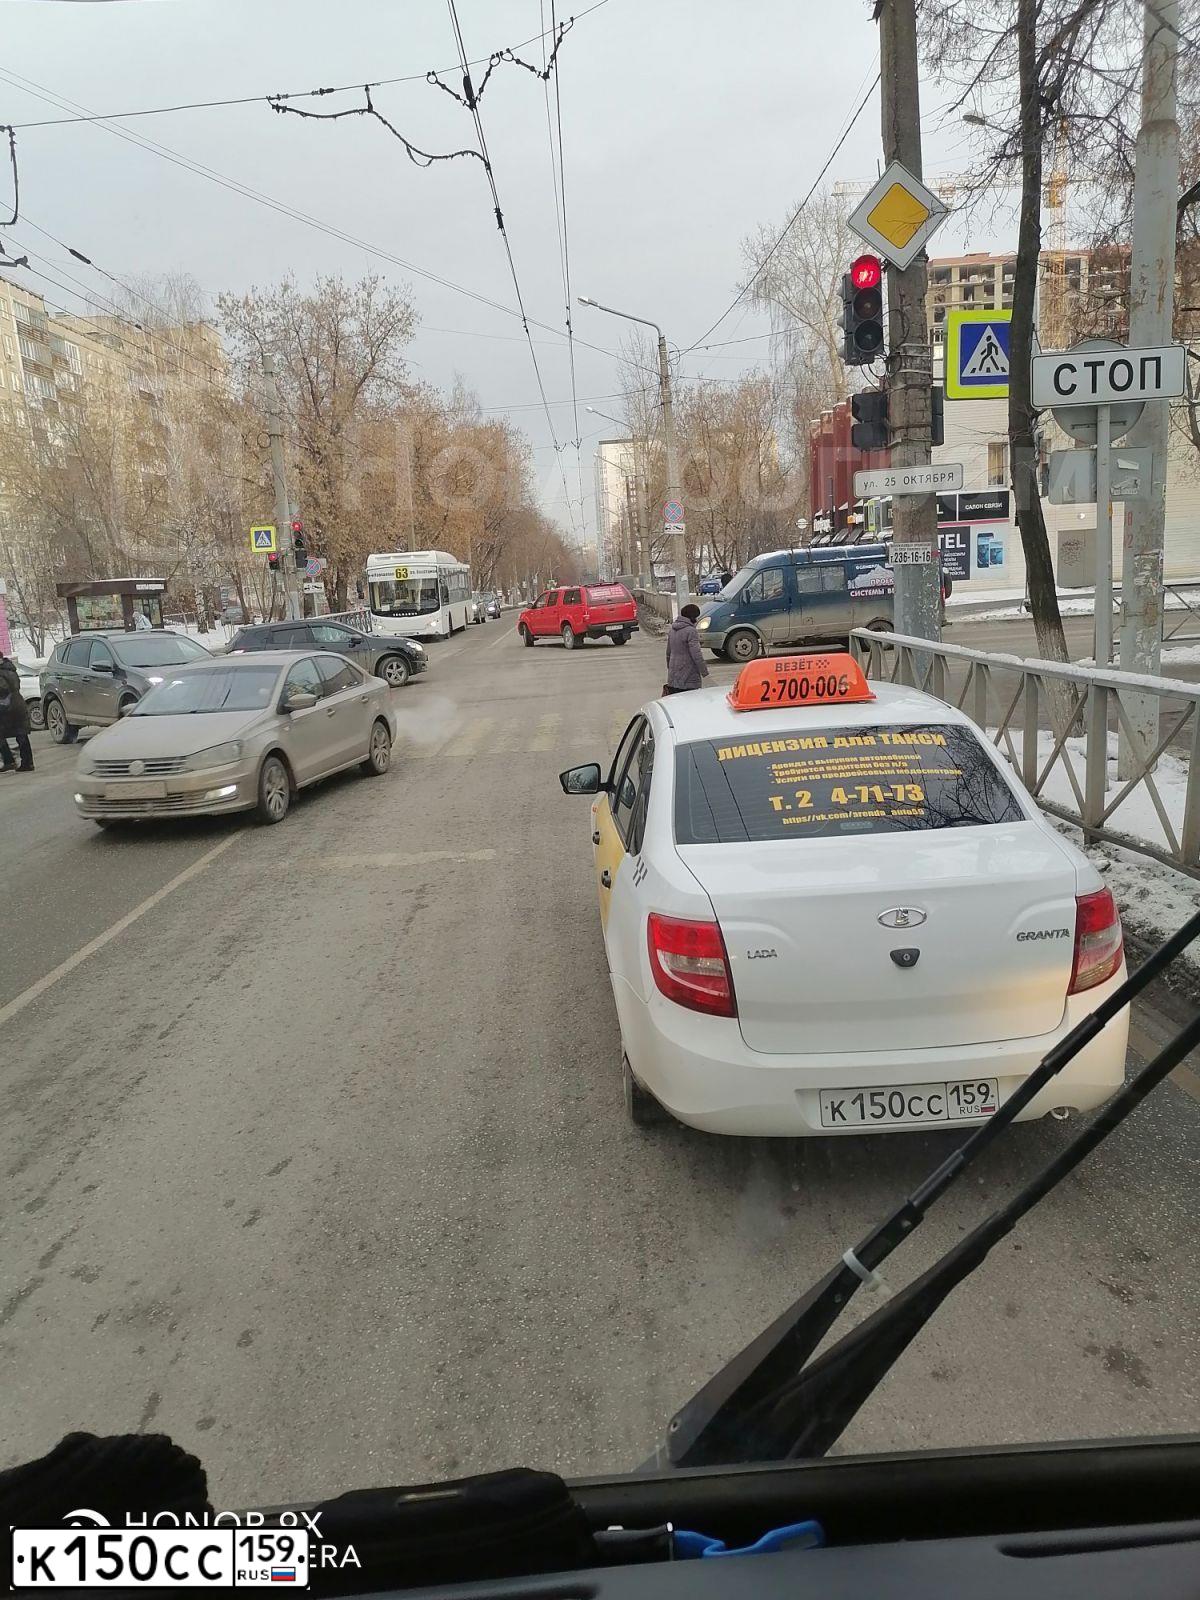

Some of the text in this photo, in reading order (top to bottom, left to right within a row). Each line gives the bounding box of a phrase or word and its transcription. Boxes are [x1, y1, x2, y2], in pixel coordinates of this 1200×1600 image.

[1053, 356, 1161, 396] СТОП
[863, 472, 954, 490] ул. 25 ОКТЯБРЯ
[395, 568, 408, 578] 63
[850, 588, 884, 597] СИСТЕМЫ
[775, 658, 813, 672] ВЕЗЁТ
[717, 736, 829, 762] ЛИЦЕНЗИЯ
[878, 732, 947, 746] ТАКСИ
[772, 761, 806, 770] Аренда
[815, 757, 858, 765] выкупом
[859, 754, 922, 762] автомобилей
[773, 766, 824, 778] Требуются
[826, 762, 872, 772] водители
[776, 776, 808, 784] Услуги
[822, 769, 896, 779] предрейсовым
[796, 790, 814, 808] 2
[831, 784, 925, 804] 4-71-73
[1016, 928, 1070, 942] GRANTA
[747, 949, 777, 960] LADA
[830, 1083, 990, 1122] К150СС 159
[960, 1106, 980, 1115] RUS
